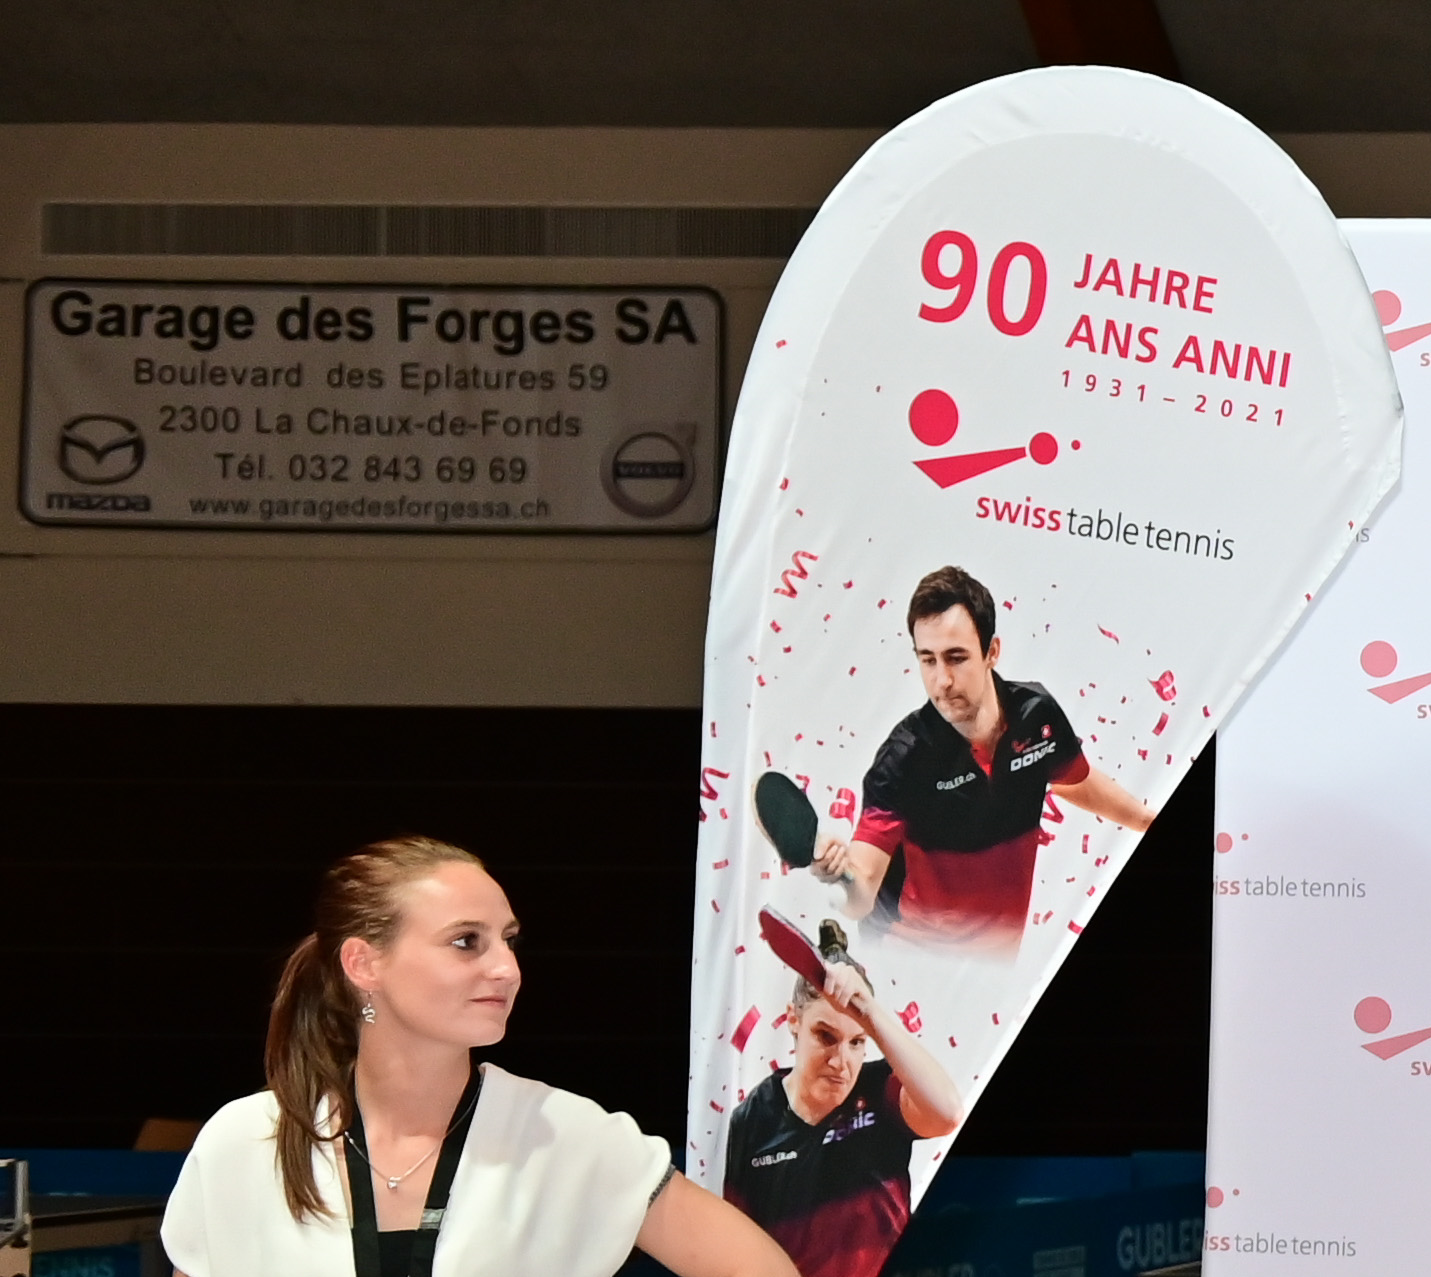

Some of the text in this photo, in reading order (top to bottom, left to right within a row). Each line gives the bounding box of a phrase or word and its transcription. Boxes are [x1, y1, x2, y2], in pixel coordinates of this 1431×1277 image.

[918, 230, 1048, 336] 90
[1073, 254, 1217, 314] JAHRE
[50, 290, 697, 354] Garage des Forges SA
[1065, 314, 1292, 388] ANS ANNI
[134, 359, 608, 397] Boulevard des Eplatures 59
[158, 406, 581, 438] 2300 La Chaux-de-Fonds
[214, 452, 527, 483] Tél. 032 843 69 69
[976, 495, 1061, 531] swiss
